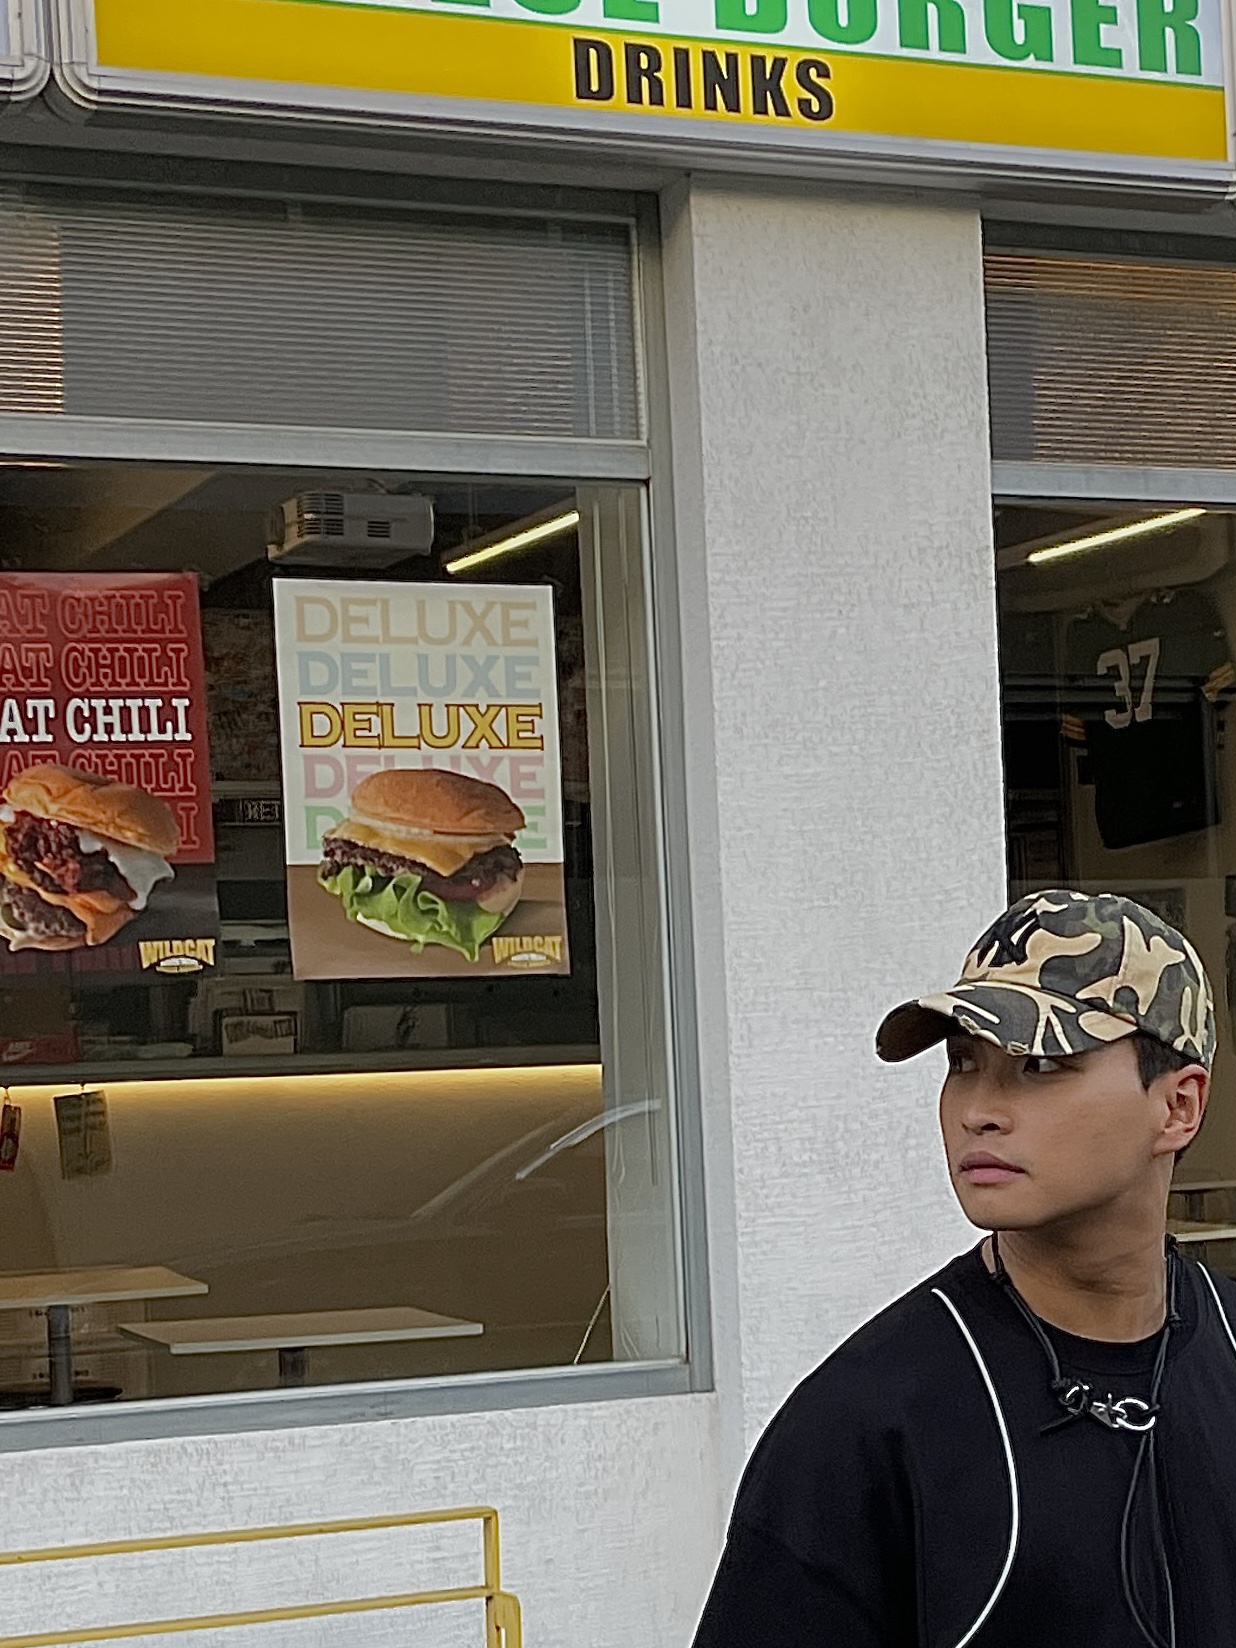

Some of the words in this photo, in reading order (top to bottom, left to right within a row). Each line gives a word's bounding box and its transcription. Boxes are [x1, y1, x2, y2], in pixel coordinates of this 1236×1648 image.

[573, 37, 834, 121] DRINKS
[57, 590, 187, 638] CHILI
[295, 595, 539, 647] DELUXE
[61, 642, 190, 692] CHILI
[296, 651, 541, 699] DELUXE
[1096, 637, 1160, 729] 37
[65, 698, 192, 743] CHILI
[297, 702, 544, 750] DELUXE
[138, 939, 216, 969] WILDCAT
[492, 935, 562, 964] WILDCAT
